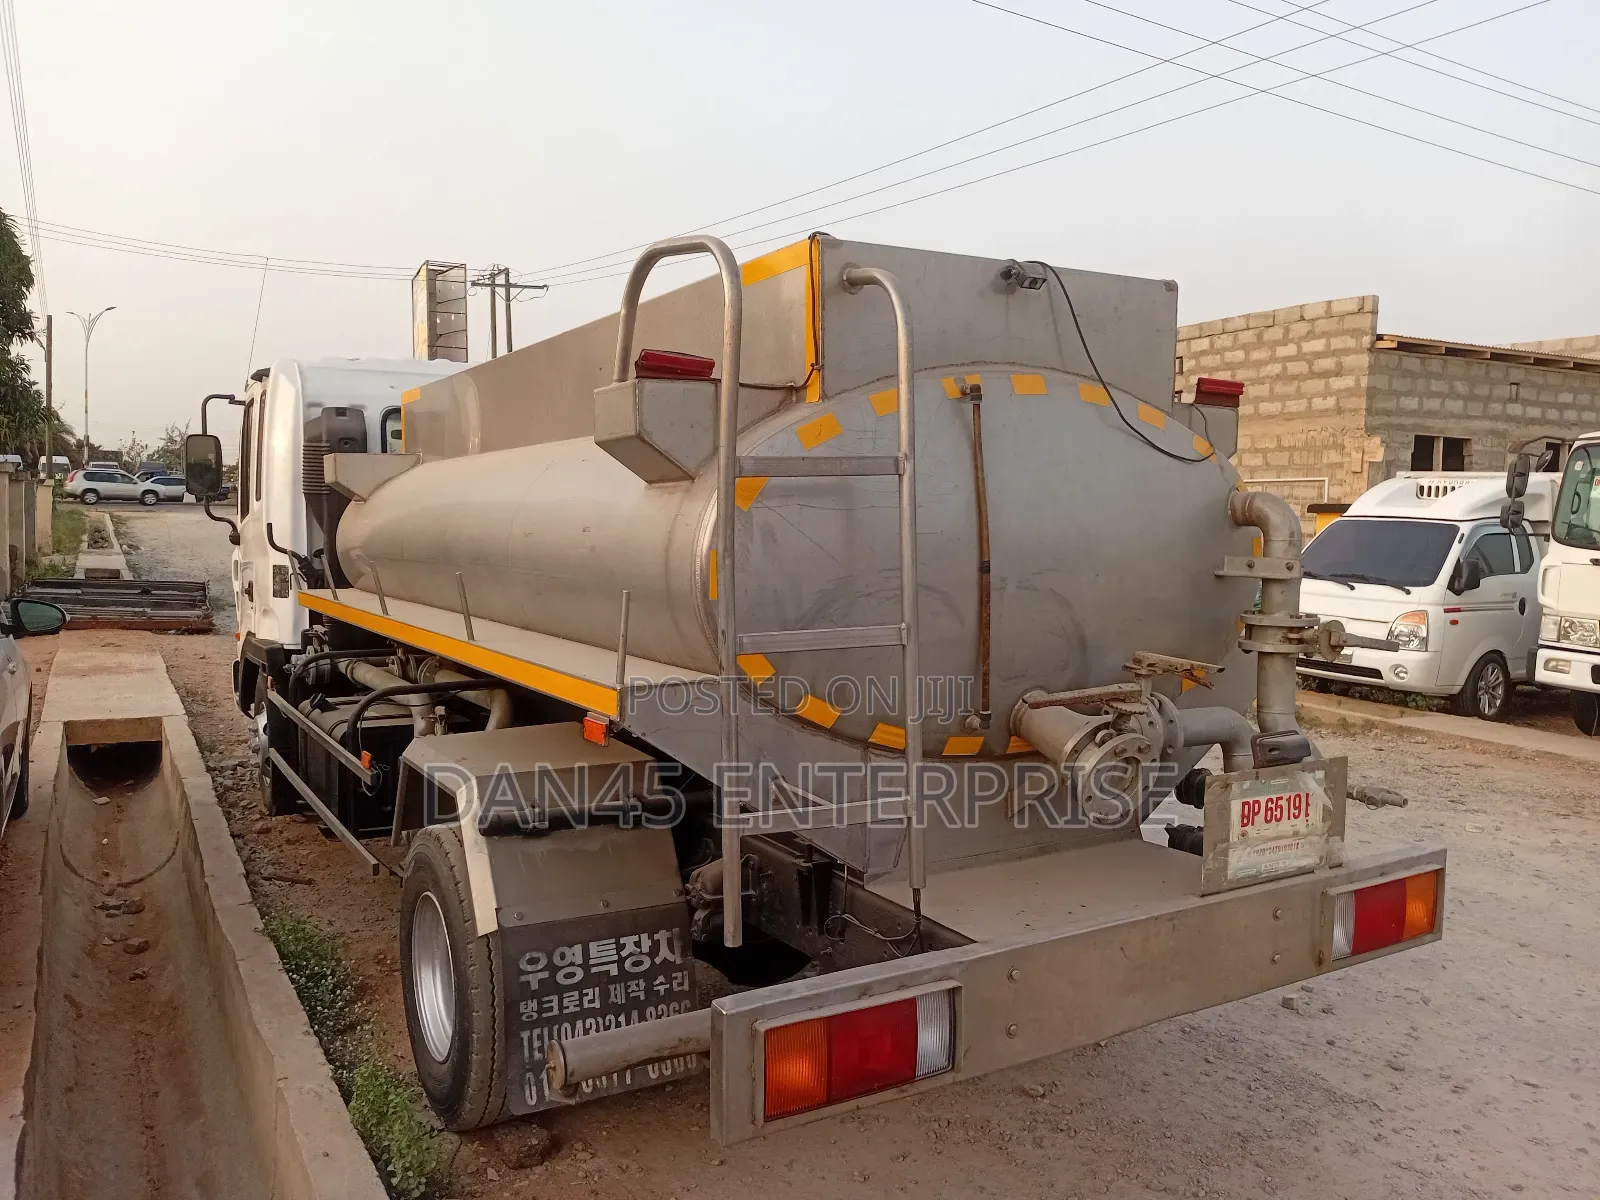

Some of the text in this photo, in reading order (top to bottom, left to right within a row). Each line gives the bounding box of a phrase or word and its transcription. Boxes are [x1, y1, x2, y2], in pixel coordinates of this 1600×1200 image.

[1264, 793, 1302, 825] 6519
[608, 979, 646, 1005] 제작
[653, 970, 690, 997] 수리
